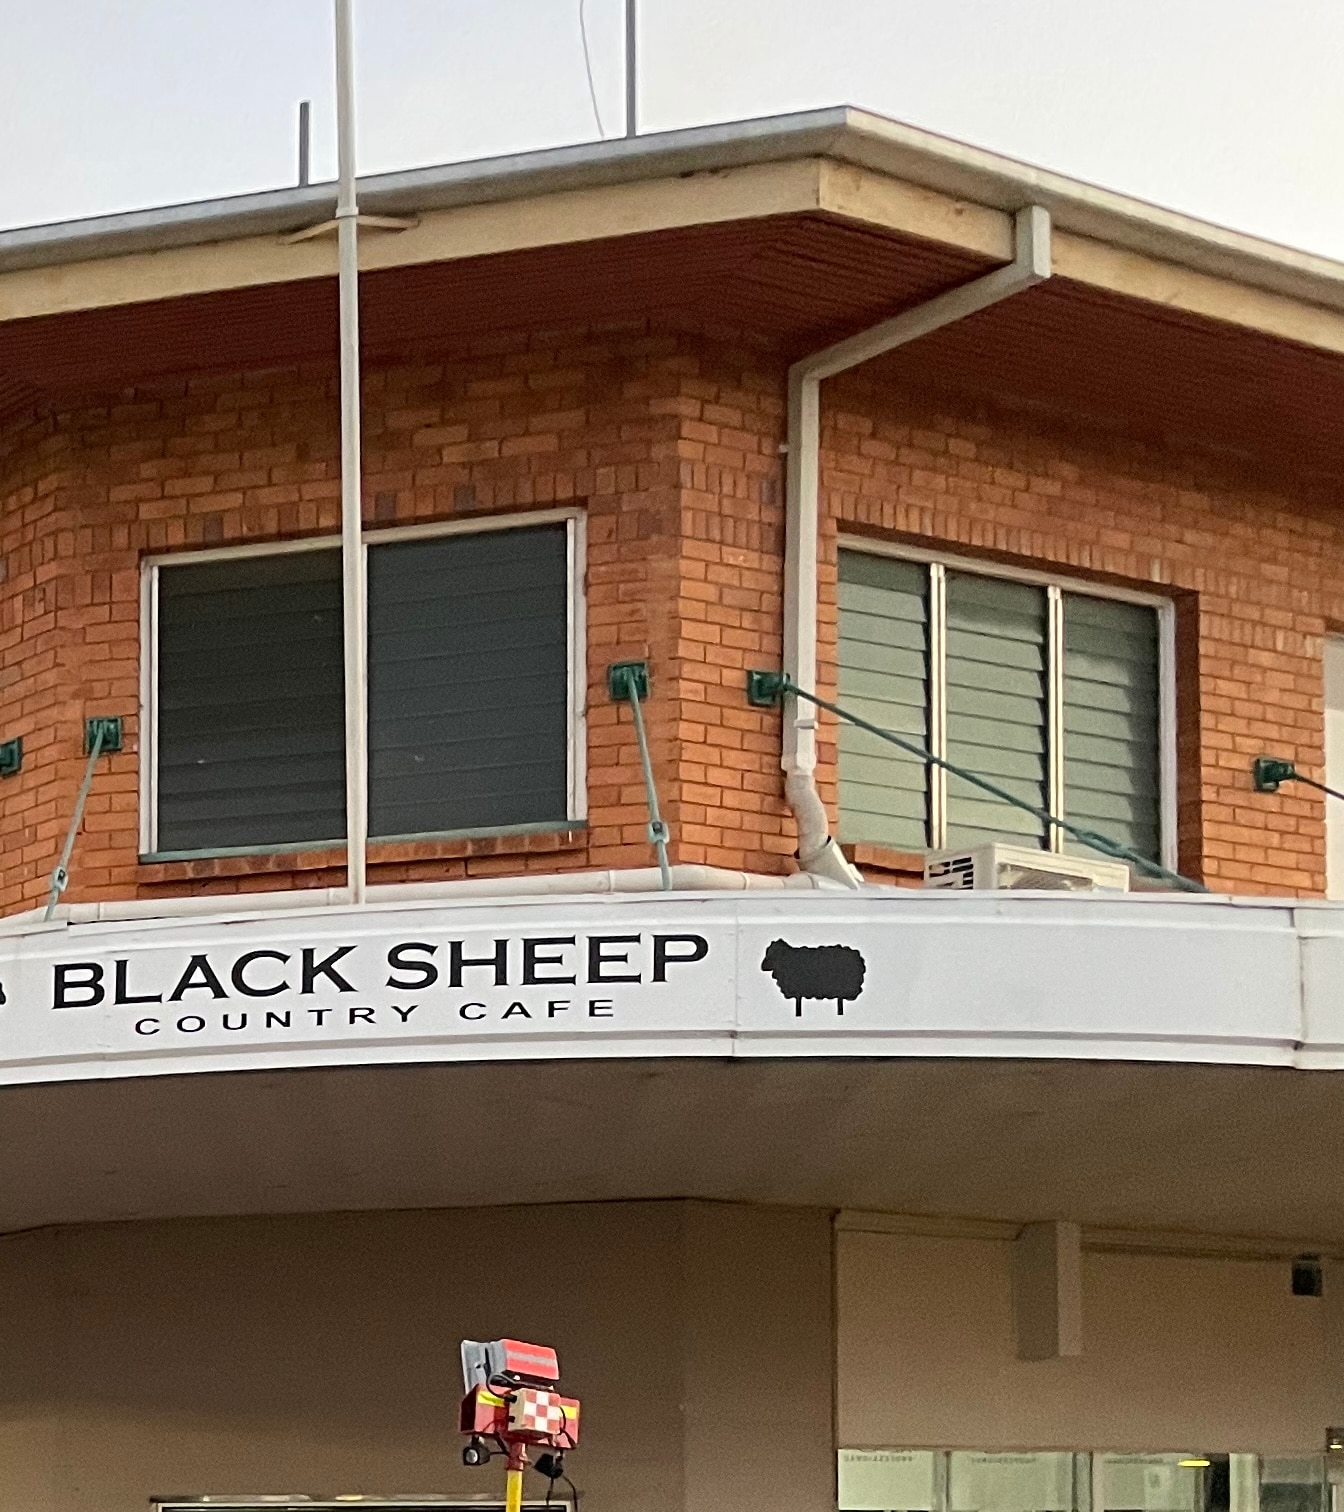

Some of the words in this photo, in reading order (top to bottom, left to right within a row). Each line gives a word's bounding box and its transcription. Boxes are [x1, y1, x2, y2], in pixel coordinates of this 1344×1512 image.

[51, 945, 359, 1010] BLACK
[385, 933, 709, 990] SHEEP
[134, 1003, 419, 1036] COUNTRY
[459, 999, 615, 1020] CAFE
